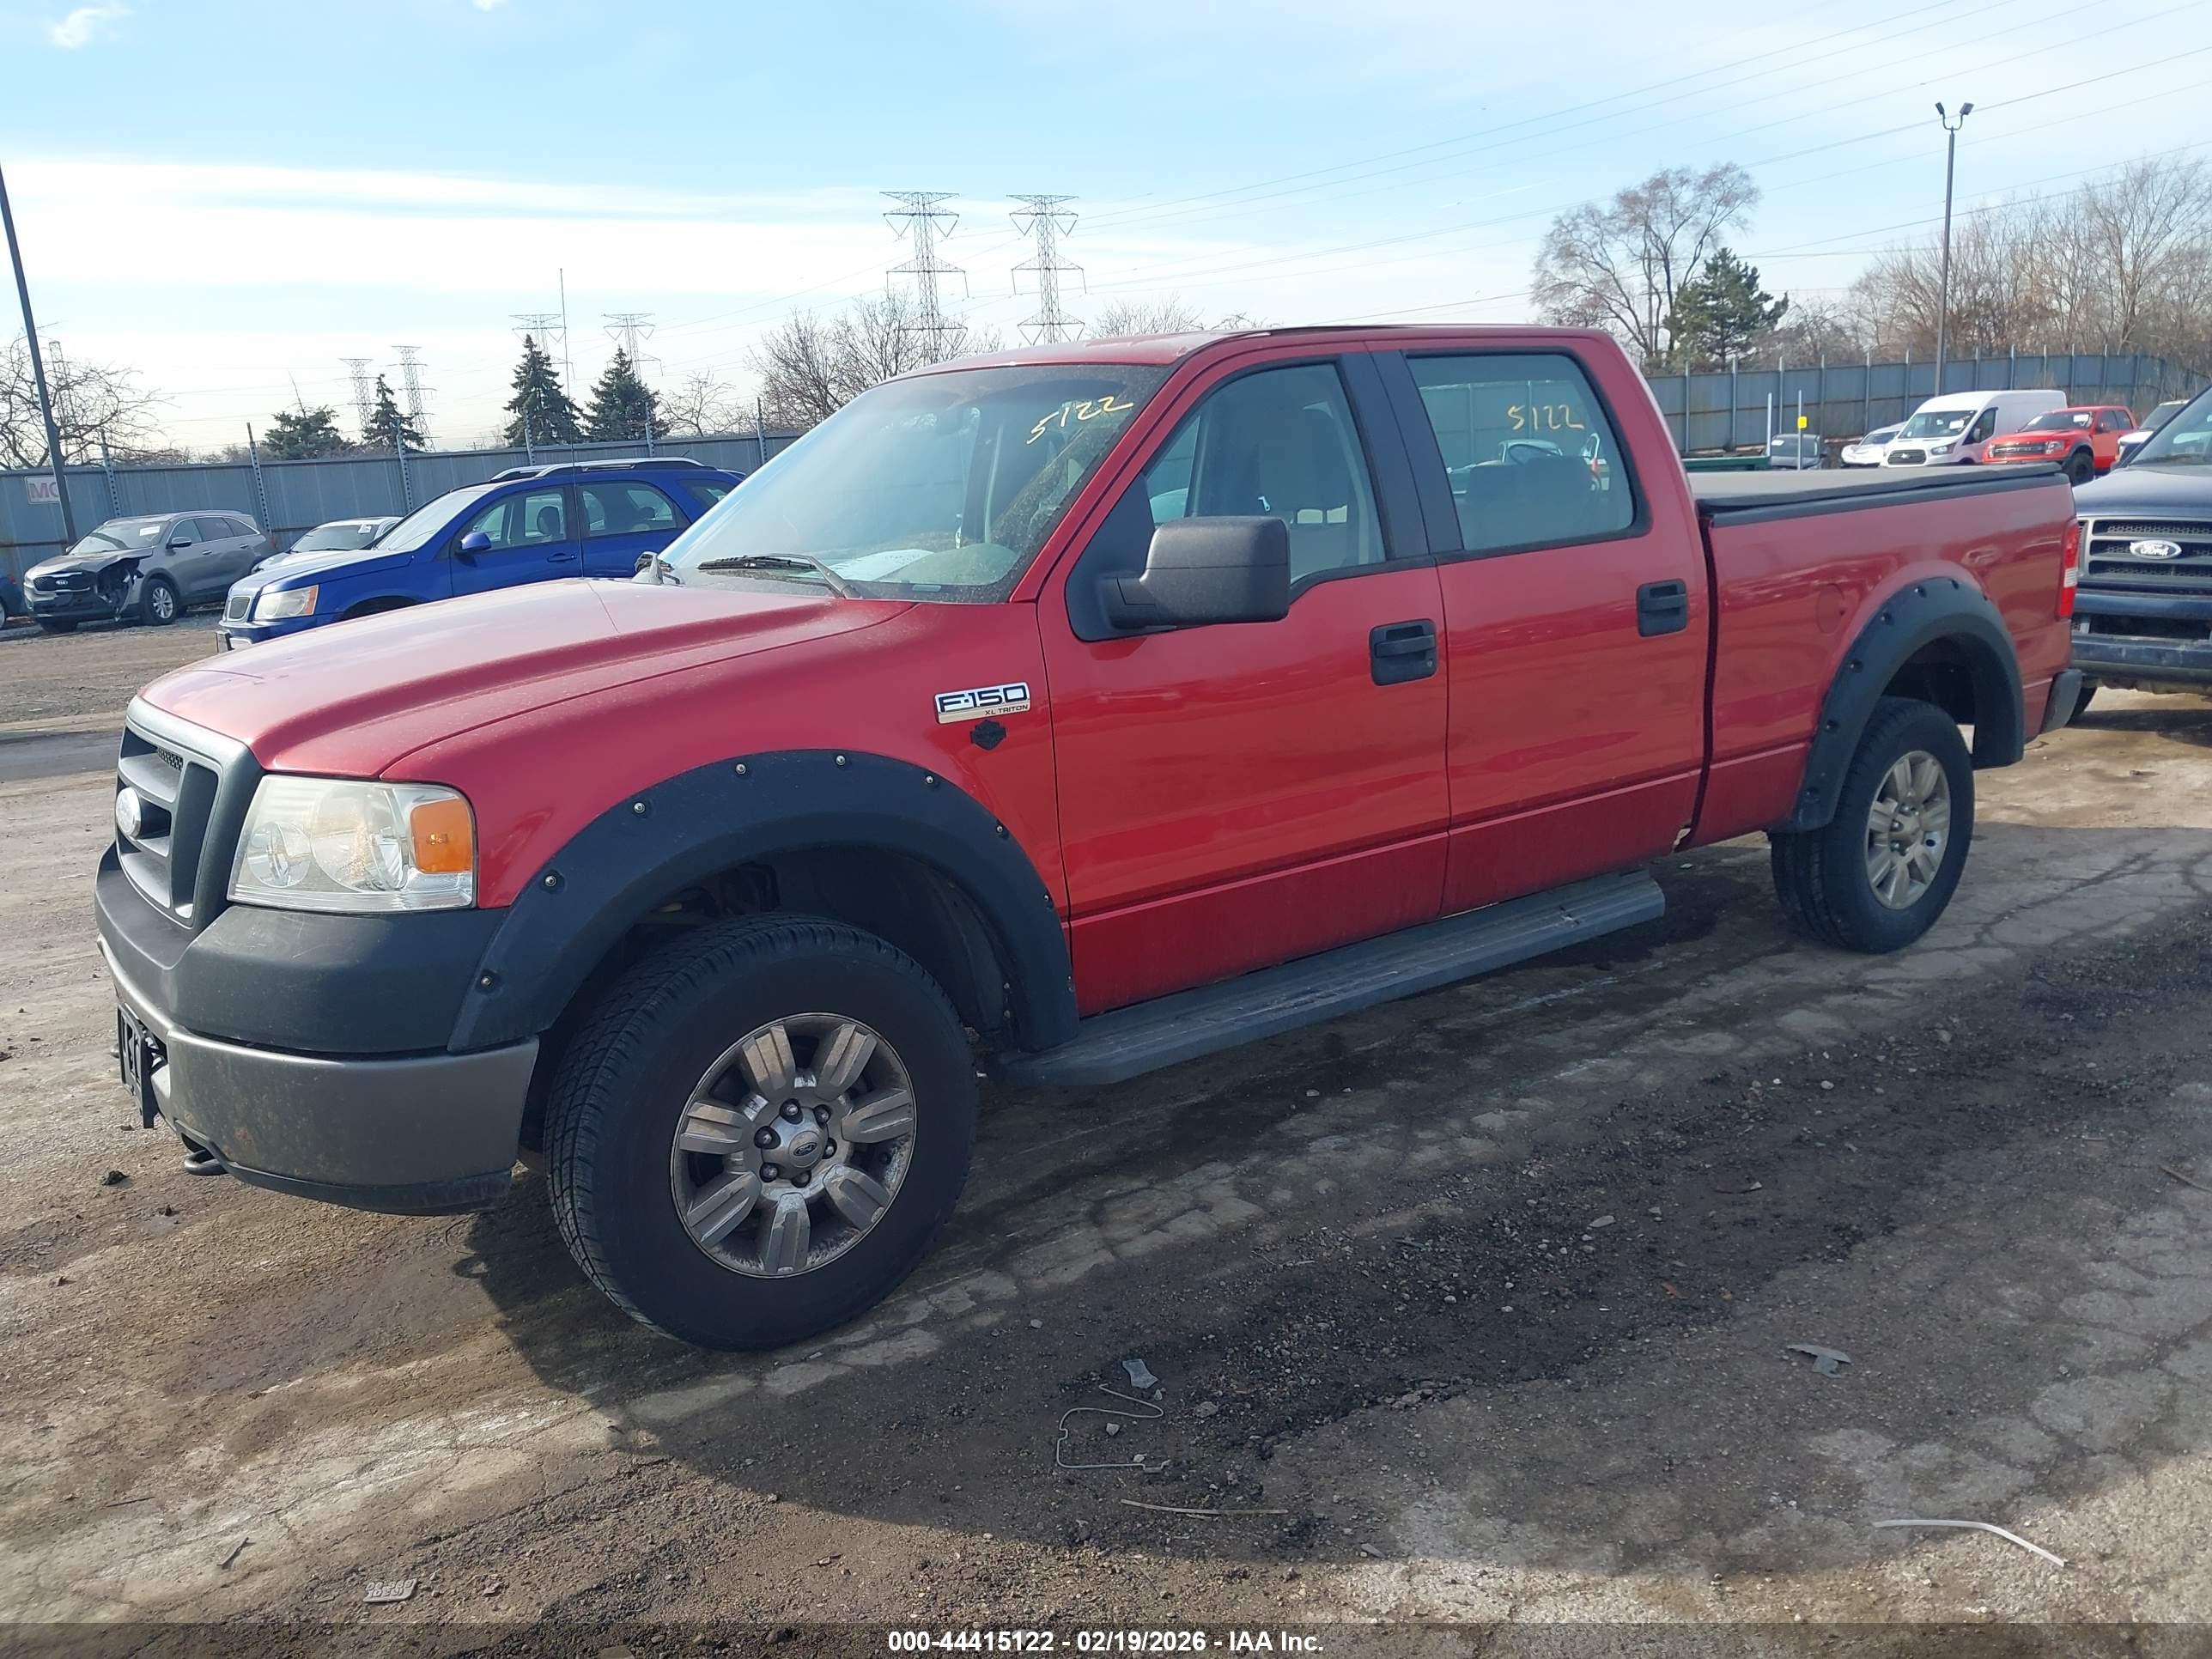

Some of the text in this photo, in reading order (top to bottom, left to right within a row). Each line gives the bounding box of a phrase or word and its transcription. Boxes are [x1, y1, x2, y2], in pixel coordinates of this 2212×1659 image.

[1027, 396, 1133, 444] 5122
[1507, 404, 1585, 431] 5122
[938, 684, 1029, 713] F-150
[997, 704, 1029, 714] TRITON
